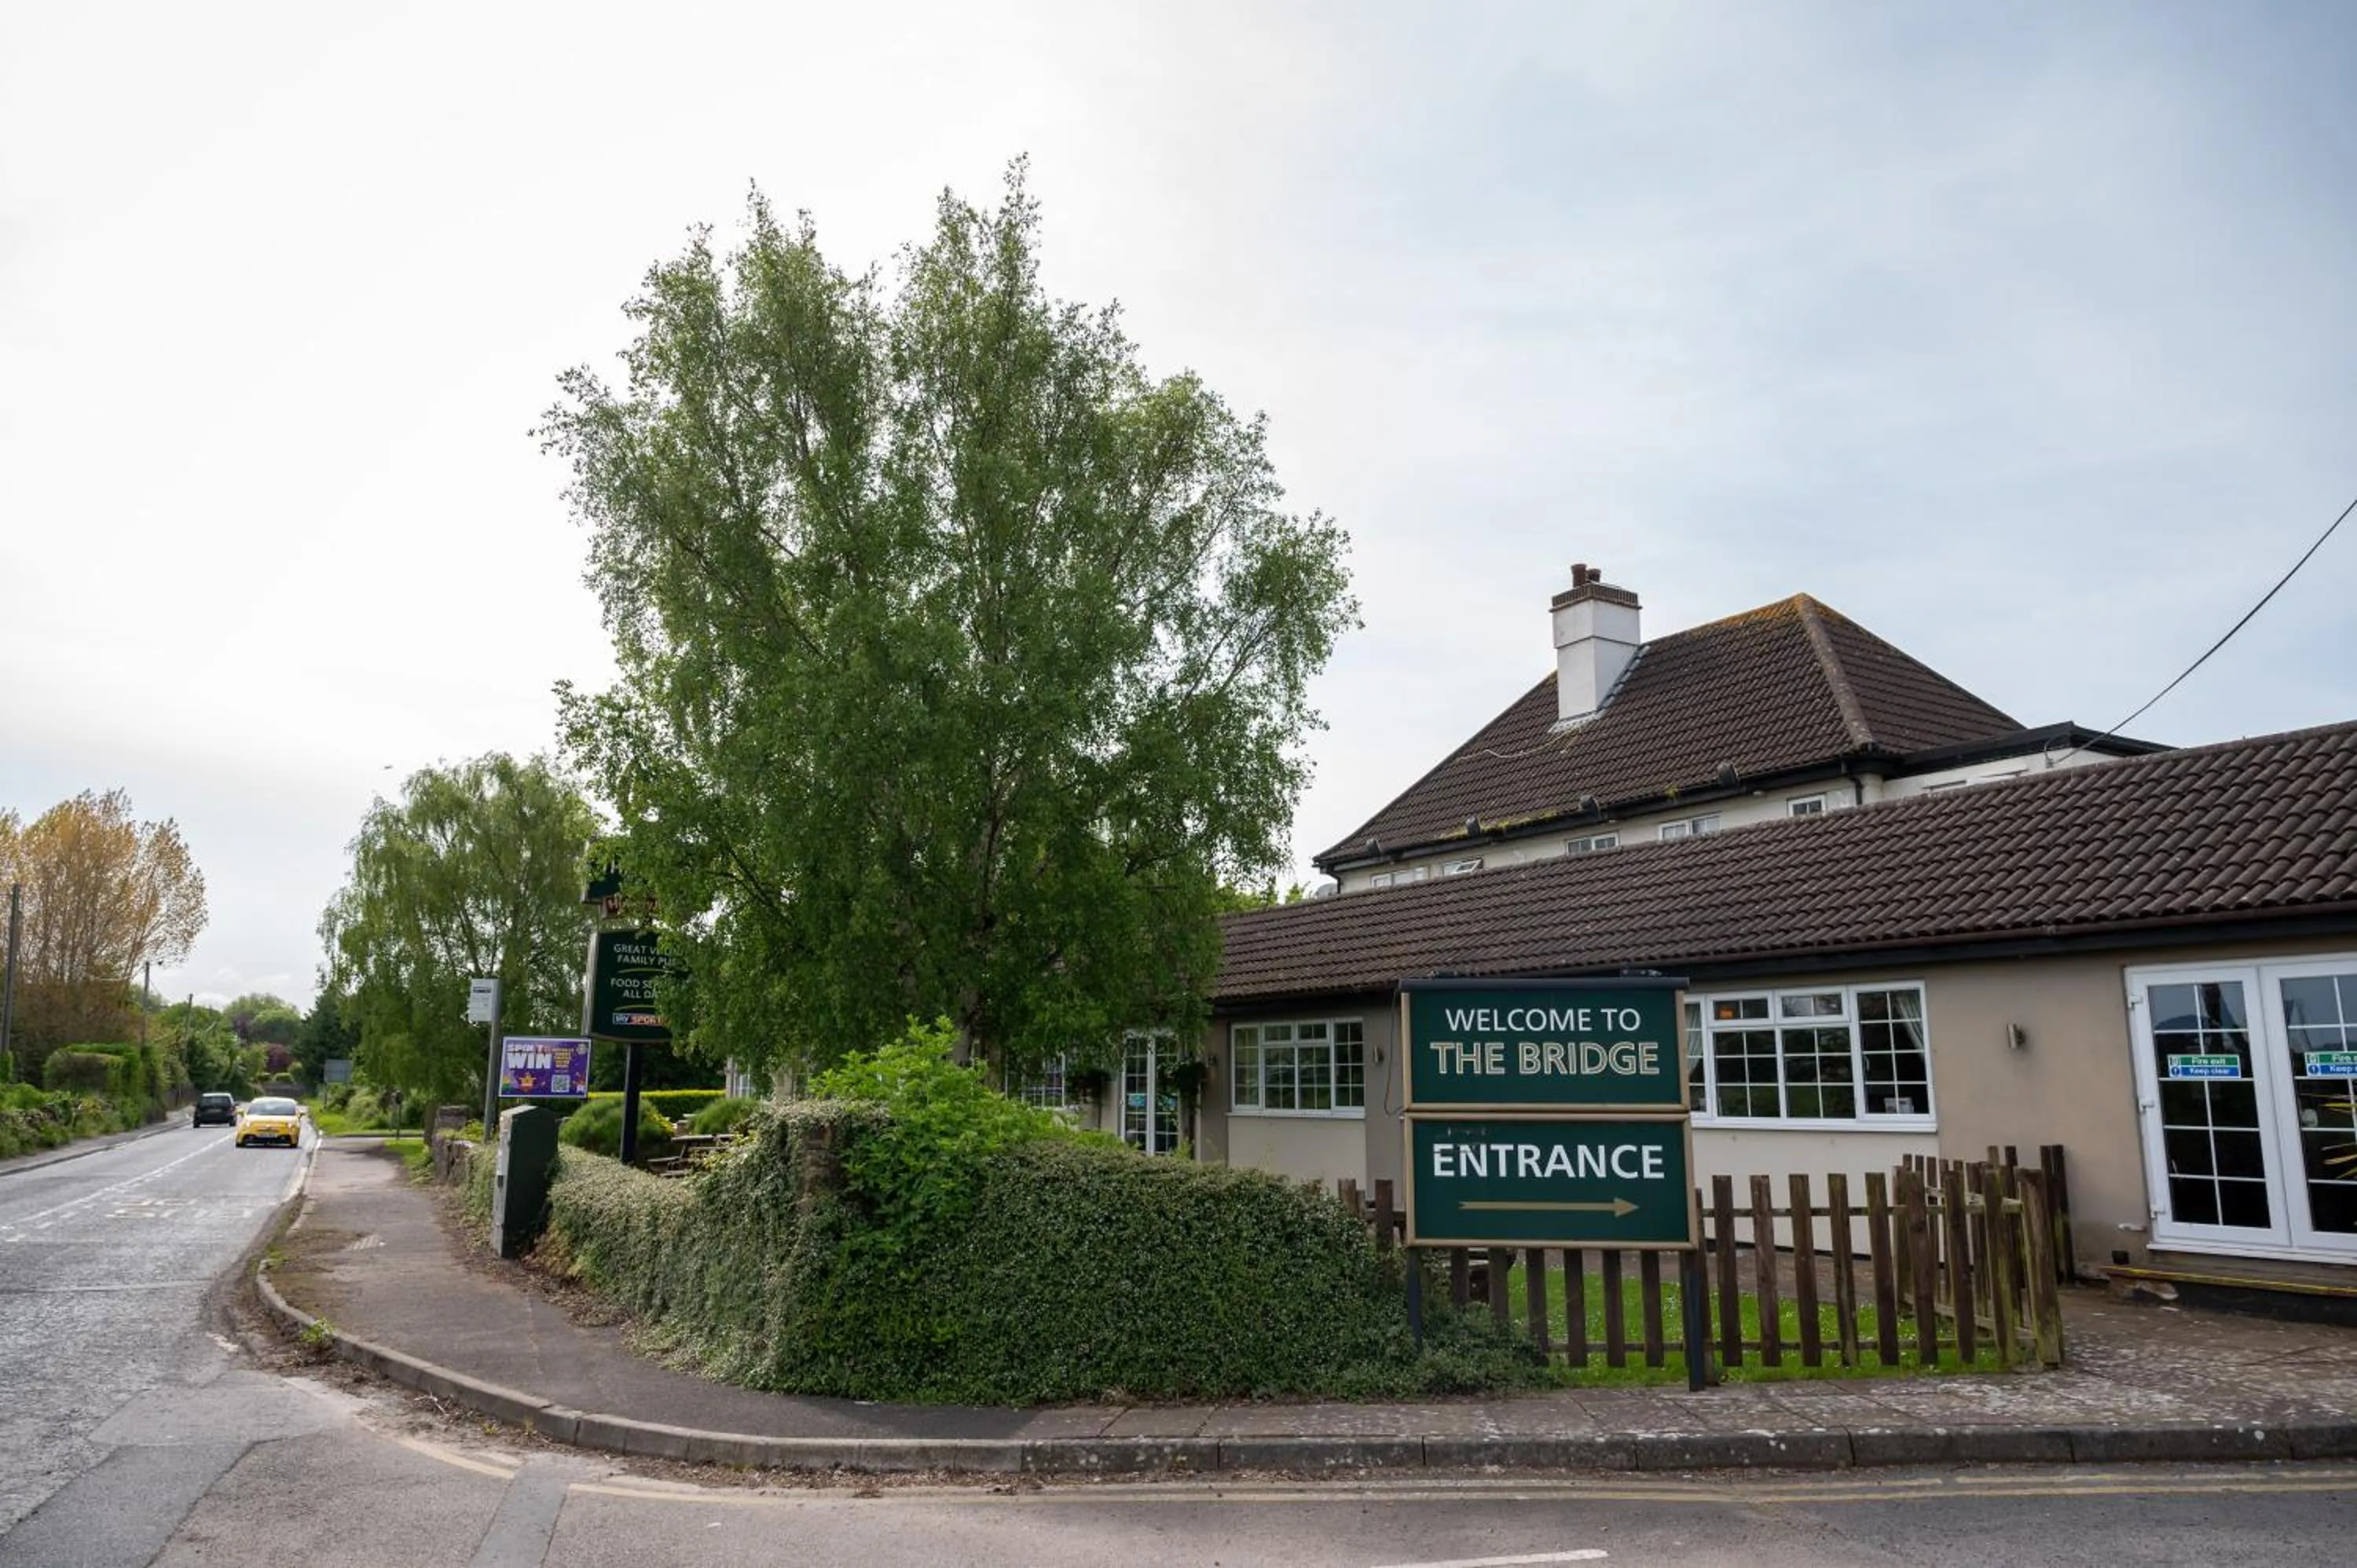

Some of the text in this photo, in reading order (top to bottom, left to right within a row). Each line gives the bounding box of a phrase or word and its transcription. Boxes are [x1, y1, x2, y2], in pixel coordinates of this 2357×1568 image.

[614, 943, 647, 954] GREAT
[617, 954, 655, 965] FAMILY
[610, 978, 640, 988] FOOD
[623, 989, 661, 999] ALL DA
[1446, 1008, 1641, 1031] WELCOME TO
[507, 1053, 552, 1069] WIN
[1430, 1042, 1660, 1075] THE BRIDGE
[2331, 1054, 2352, 1063] Fire
[2190, 1068, 2210, 1076] Keep
[2330, 1065, 2353, 1075] Keep
[1433, 1143, 1665, 1179] ENTRANCE
